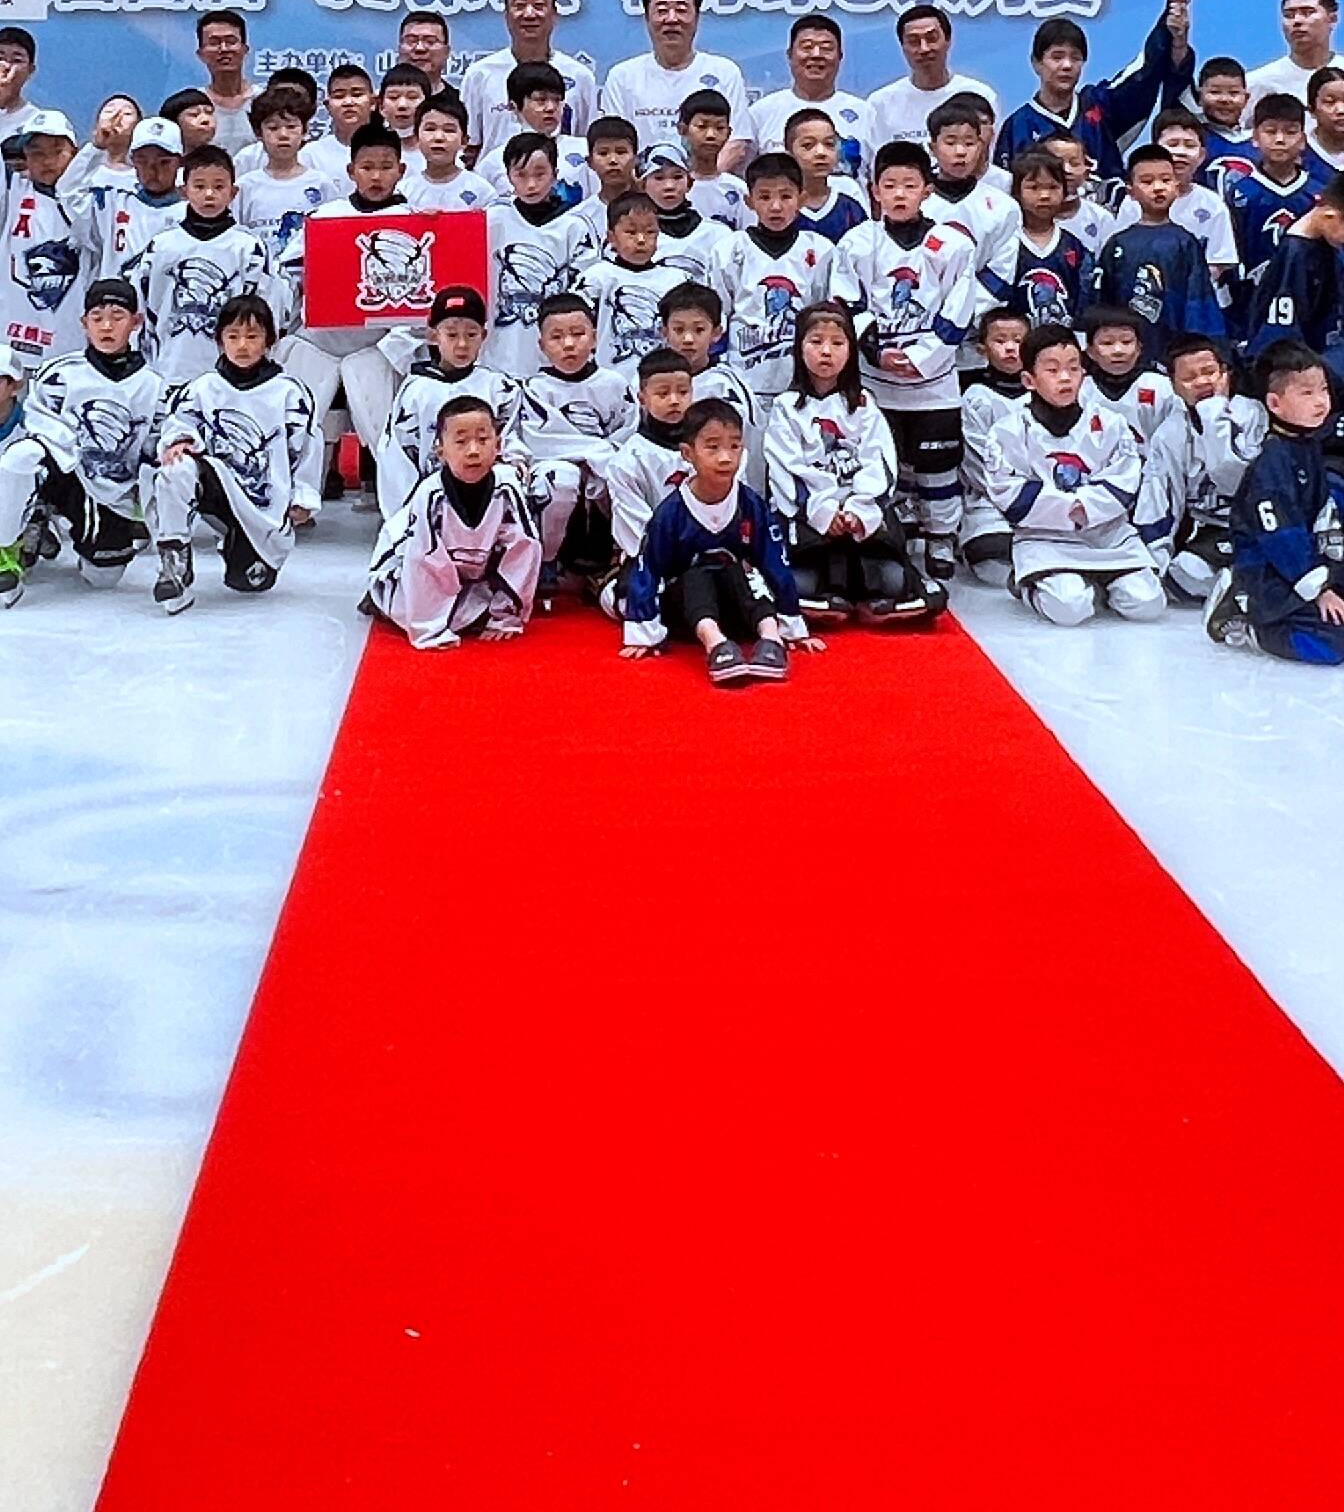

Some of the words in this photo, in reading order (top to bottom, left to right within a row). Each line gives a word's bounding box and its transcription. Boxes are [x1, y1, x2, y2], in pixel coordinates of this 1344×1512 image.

[12, 214, 31, 238] A
[1267, 296, 1294, 326] 19
[1258, 500, 1278, 531] 6
